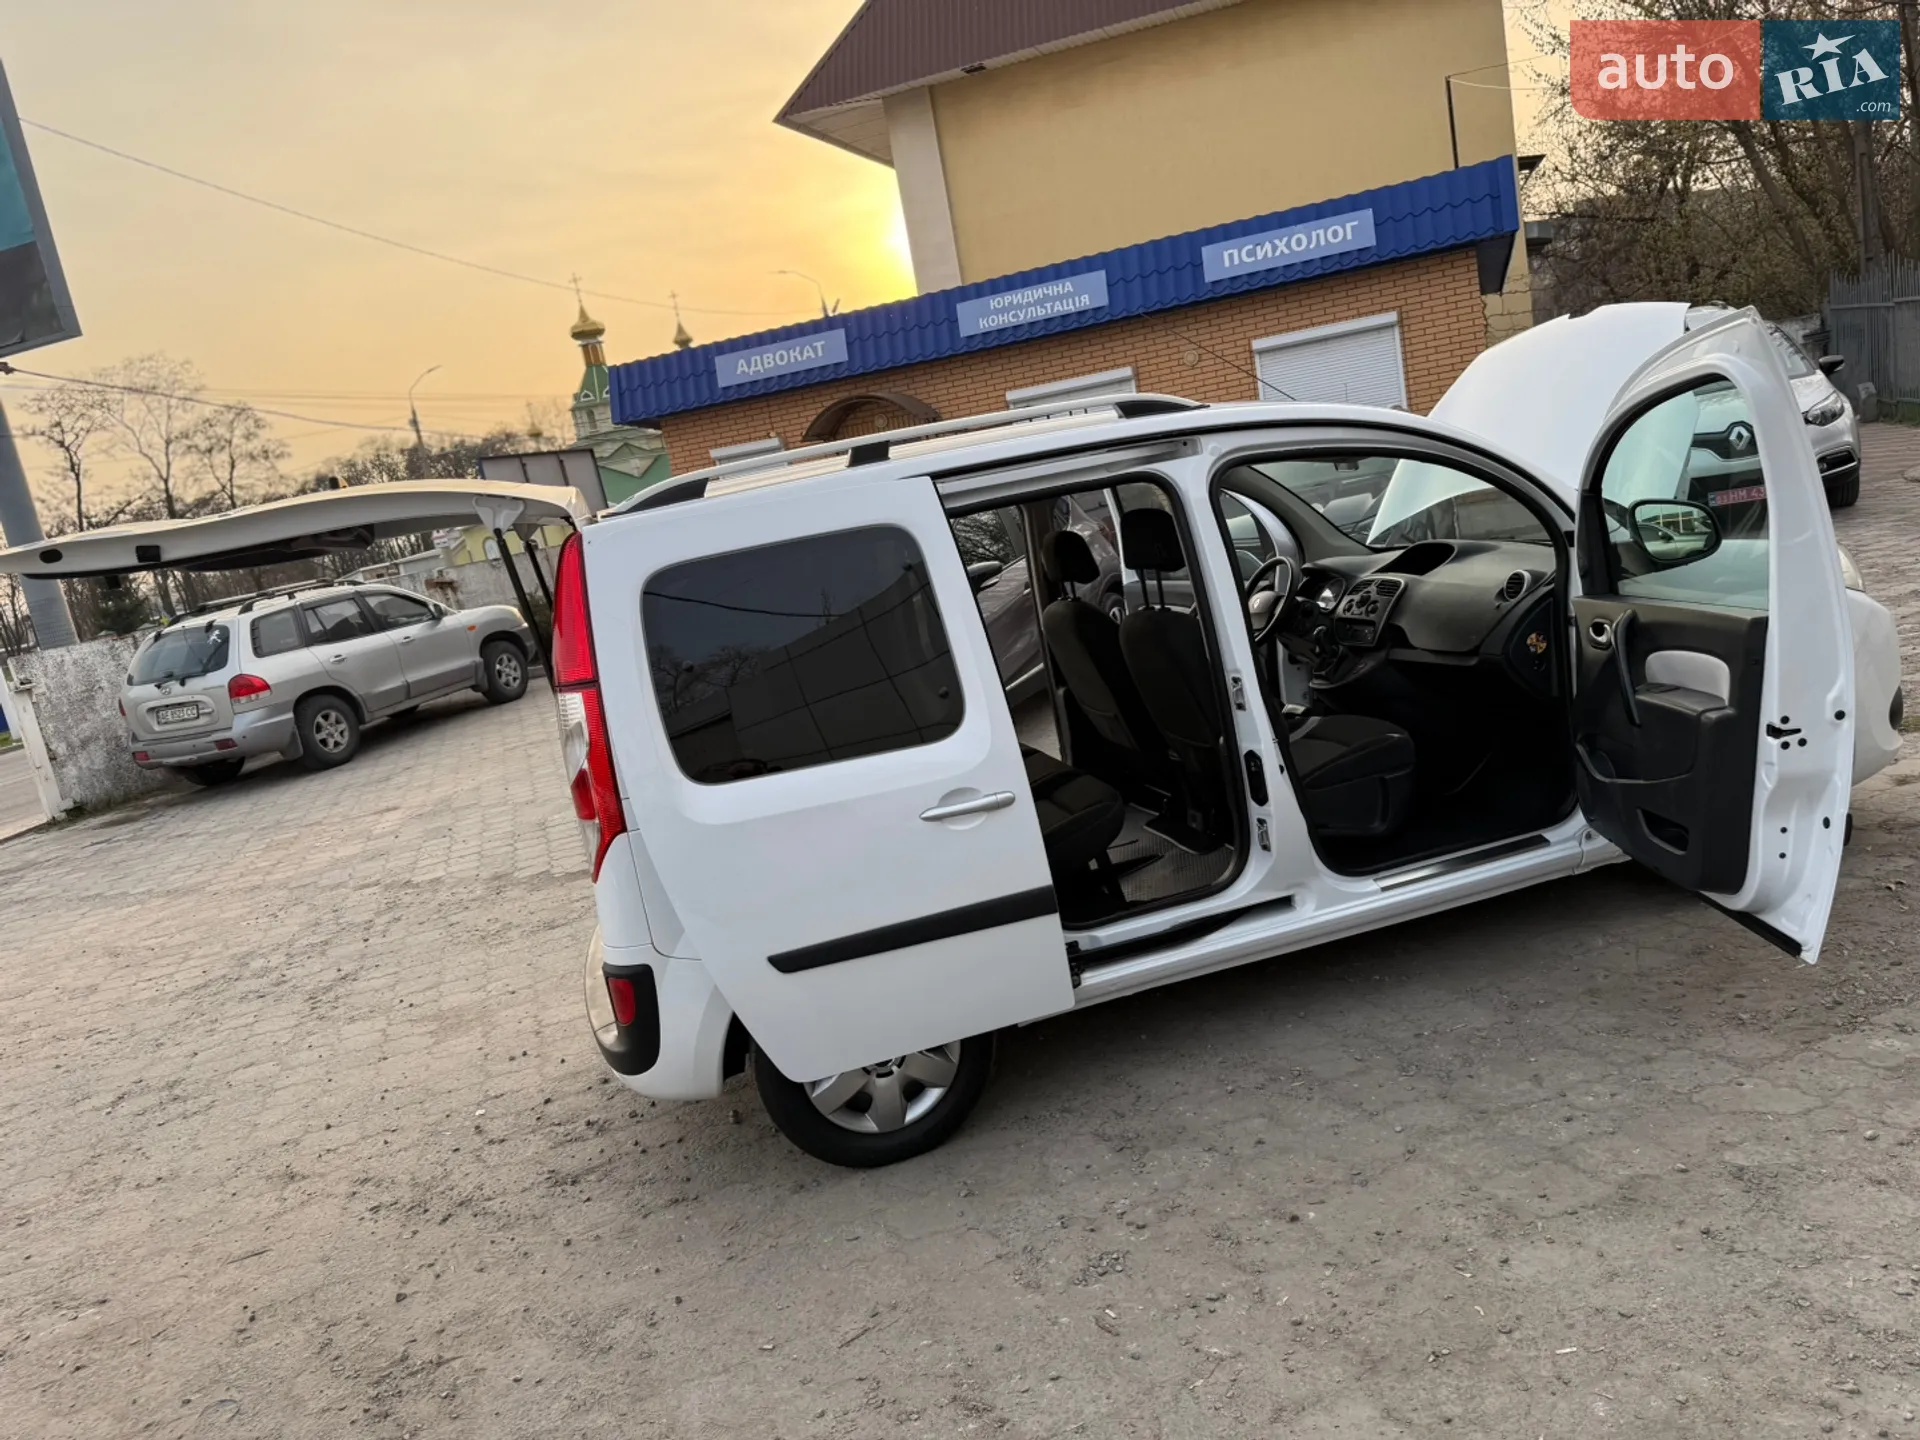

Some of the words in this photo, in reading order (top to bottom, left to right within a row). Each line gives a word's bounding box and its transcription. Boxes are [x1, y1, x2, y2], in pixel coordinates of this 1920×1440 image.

[1222, 220, 1359, 268] ПСИХОЛОГ
[978, 294, 1090, 330] КОНСУЛЬТАЦІЯ
[989, 281, 1074, 310] ЮРИДИЧНА
[736, 340, 825, 376] АДВОКАТ
